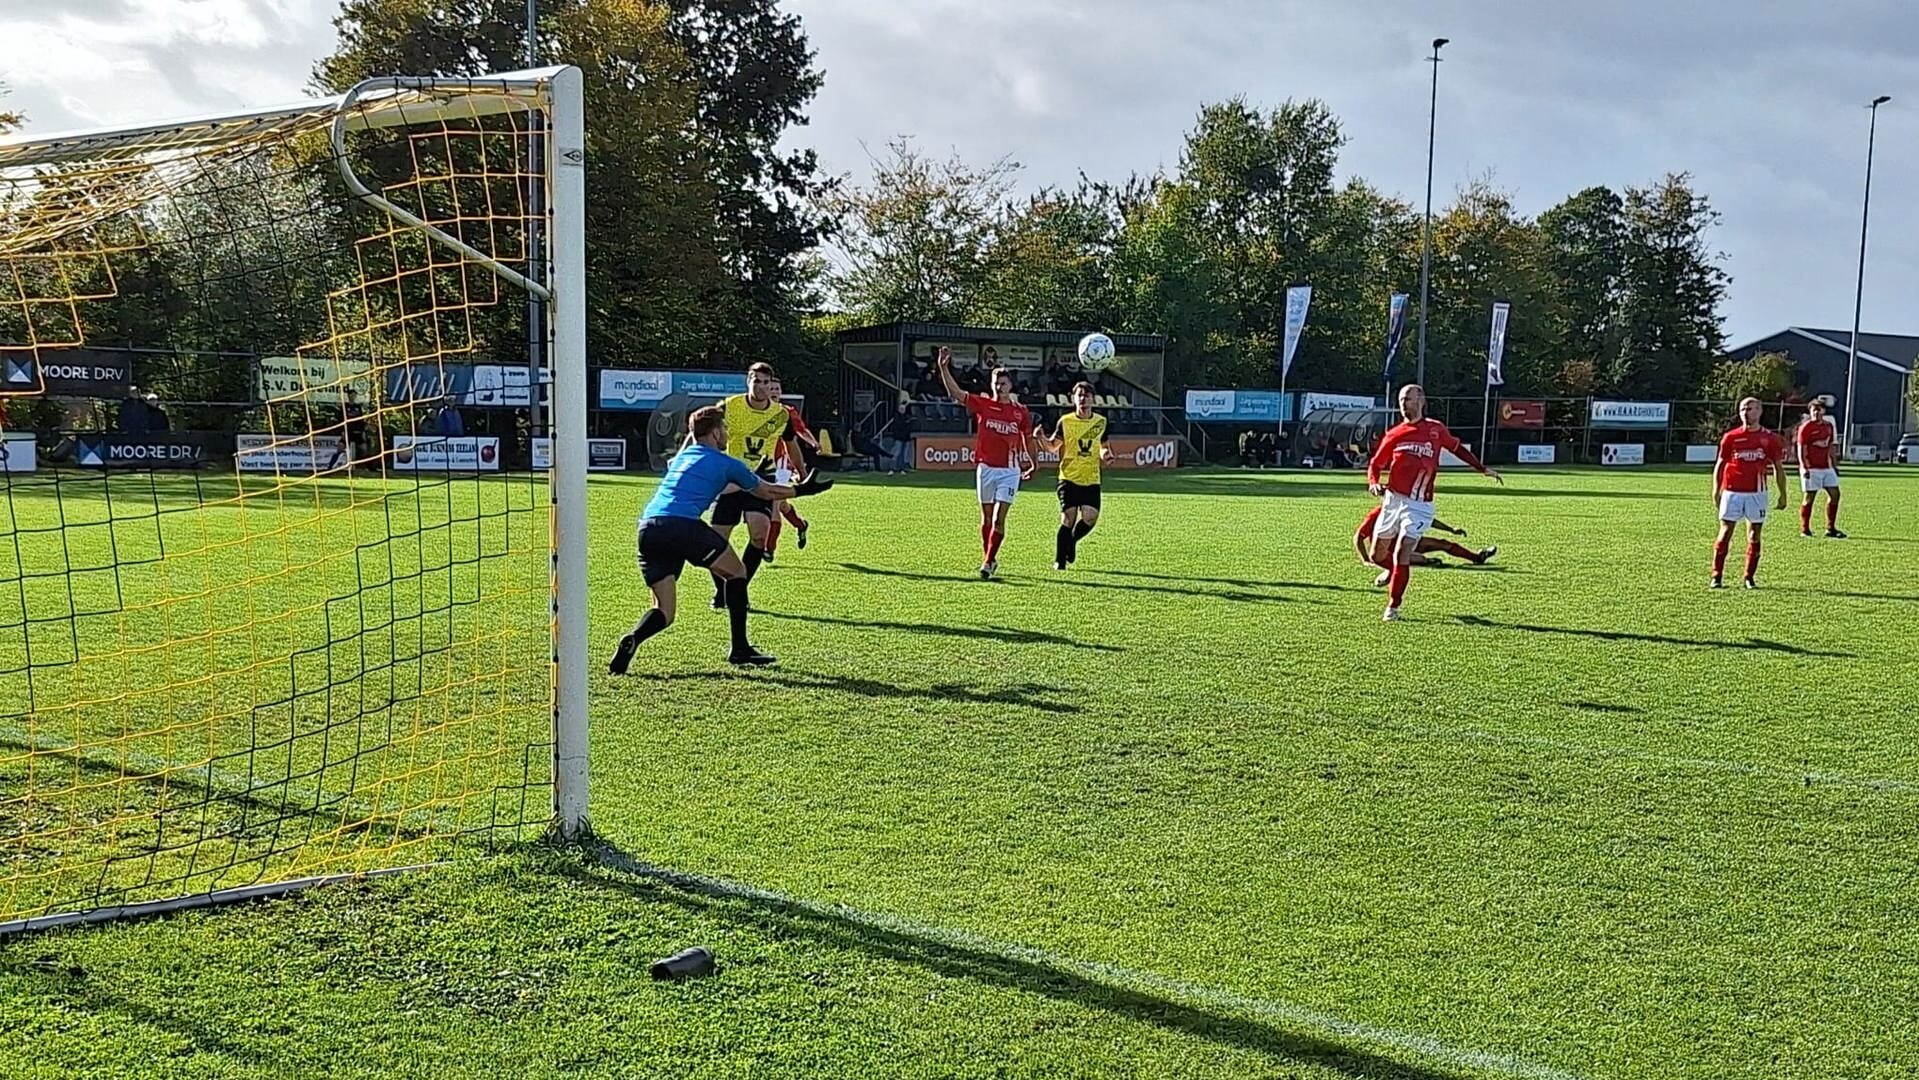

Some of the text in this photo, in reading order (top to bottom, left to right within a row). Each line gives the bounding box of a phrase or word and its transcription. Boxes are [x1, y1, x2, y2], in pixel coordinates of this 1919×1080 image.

[39, 365, 124, 380] MOORE DRV
[262, 365, 325, 379] Welkom bij
[110, 445, 166, 458] MOORE
[924, 447, 958, 465] Coop
[1135, 441, 1174, 467] coop
